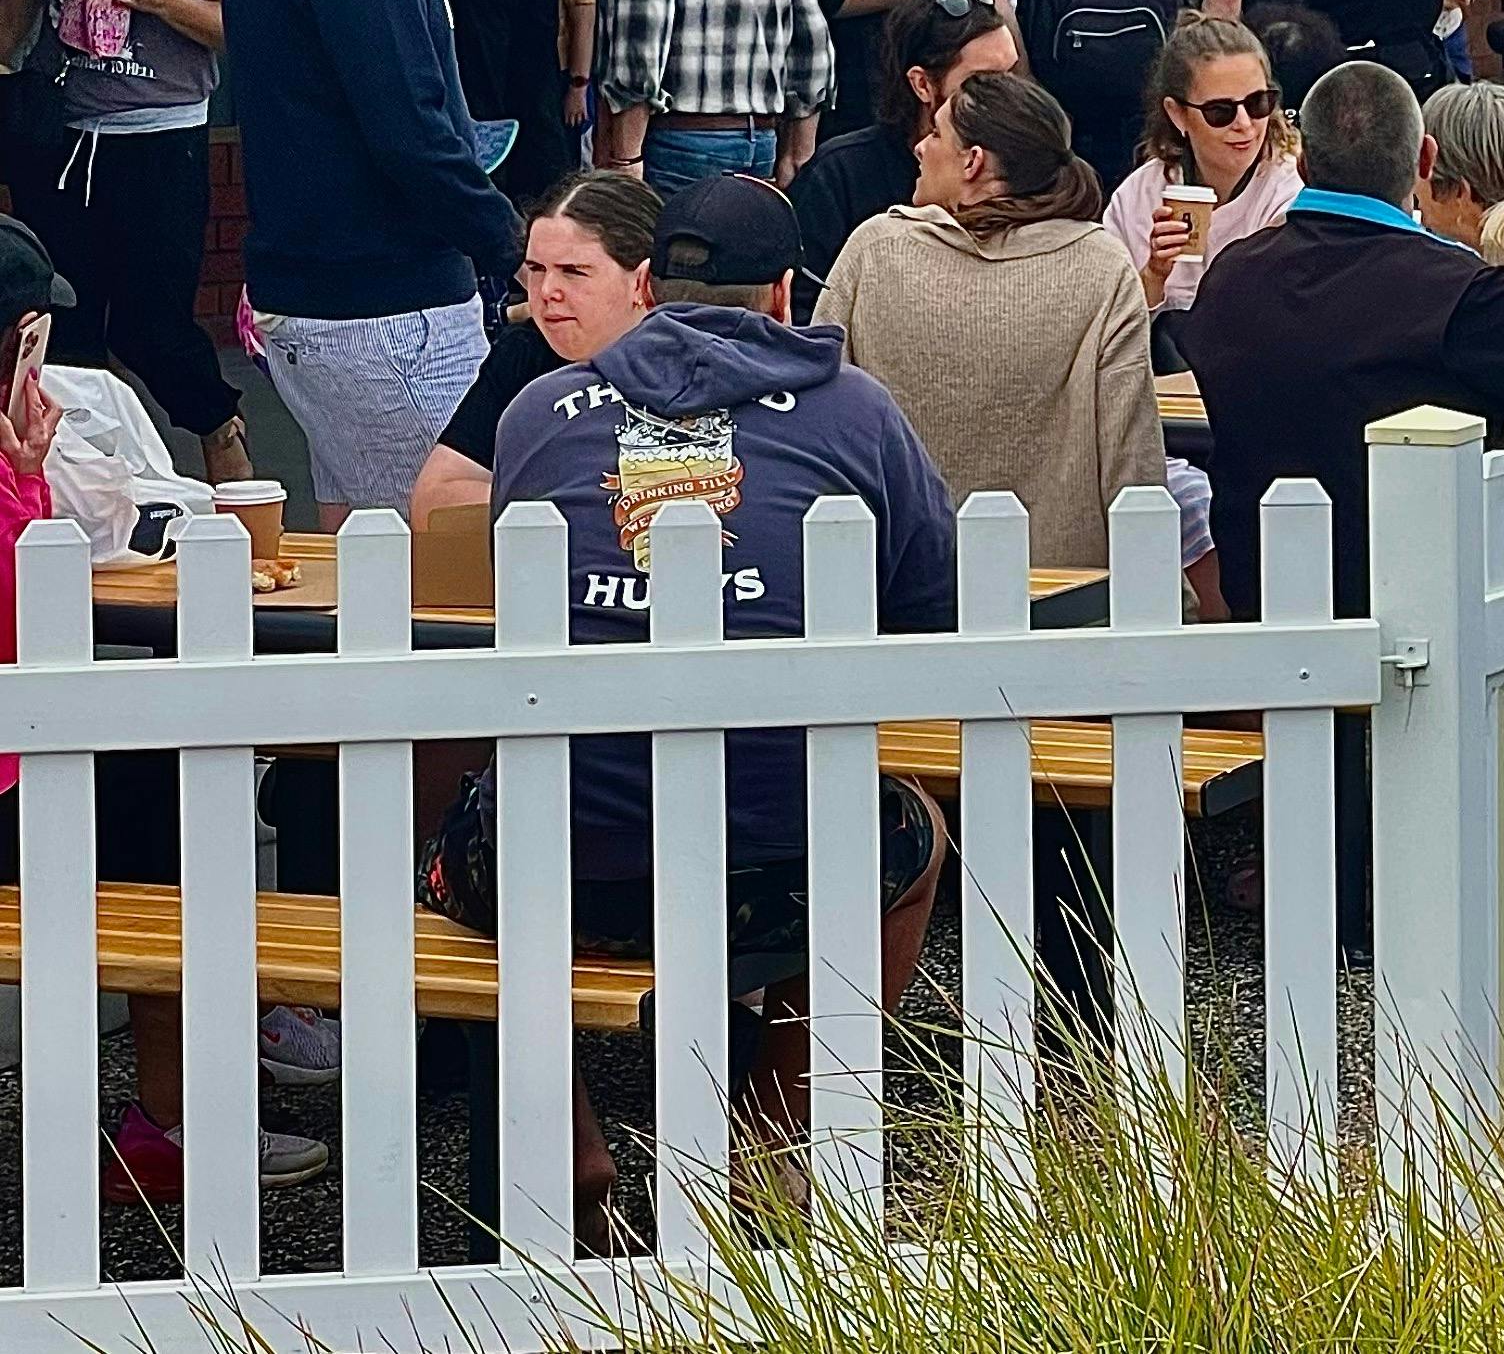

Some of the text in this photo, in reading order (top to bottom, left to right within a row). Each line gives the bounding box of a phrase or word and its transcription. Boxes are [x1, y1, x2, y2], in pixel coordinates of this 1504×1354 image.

[112, 60, 124, 74] TO
[553, 381, 625, 421] TH
[620, 481, 694, 511] DRINKING
[699, 474, 736, 490] TILL
